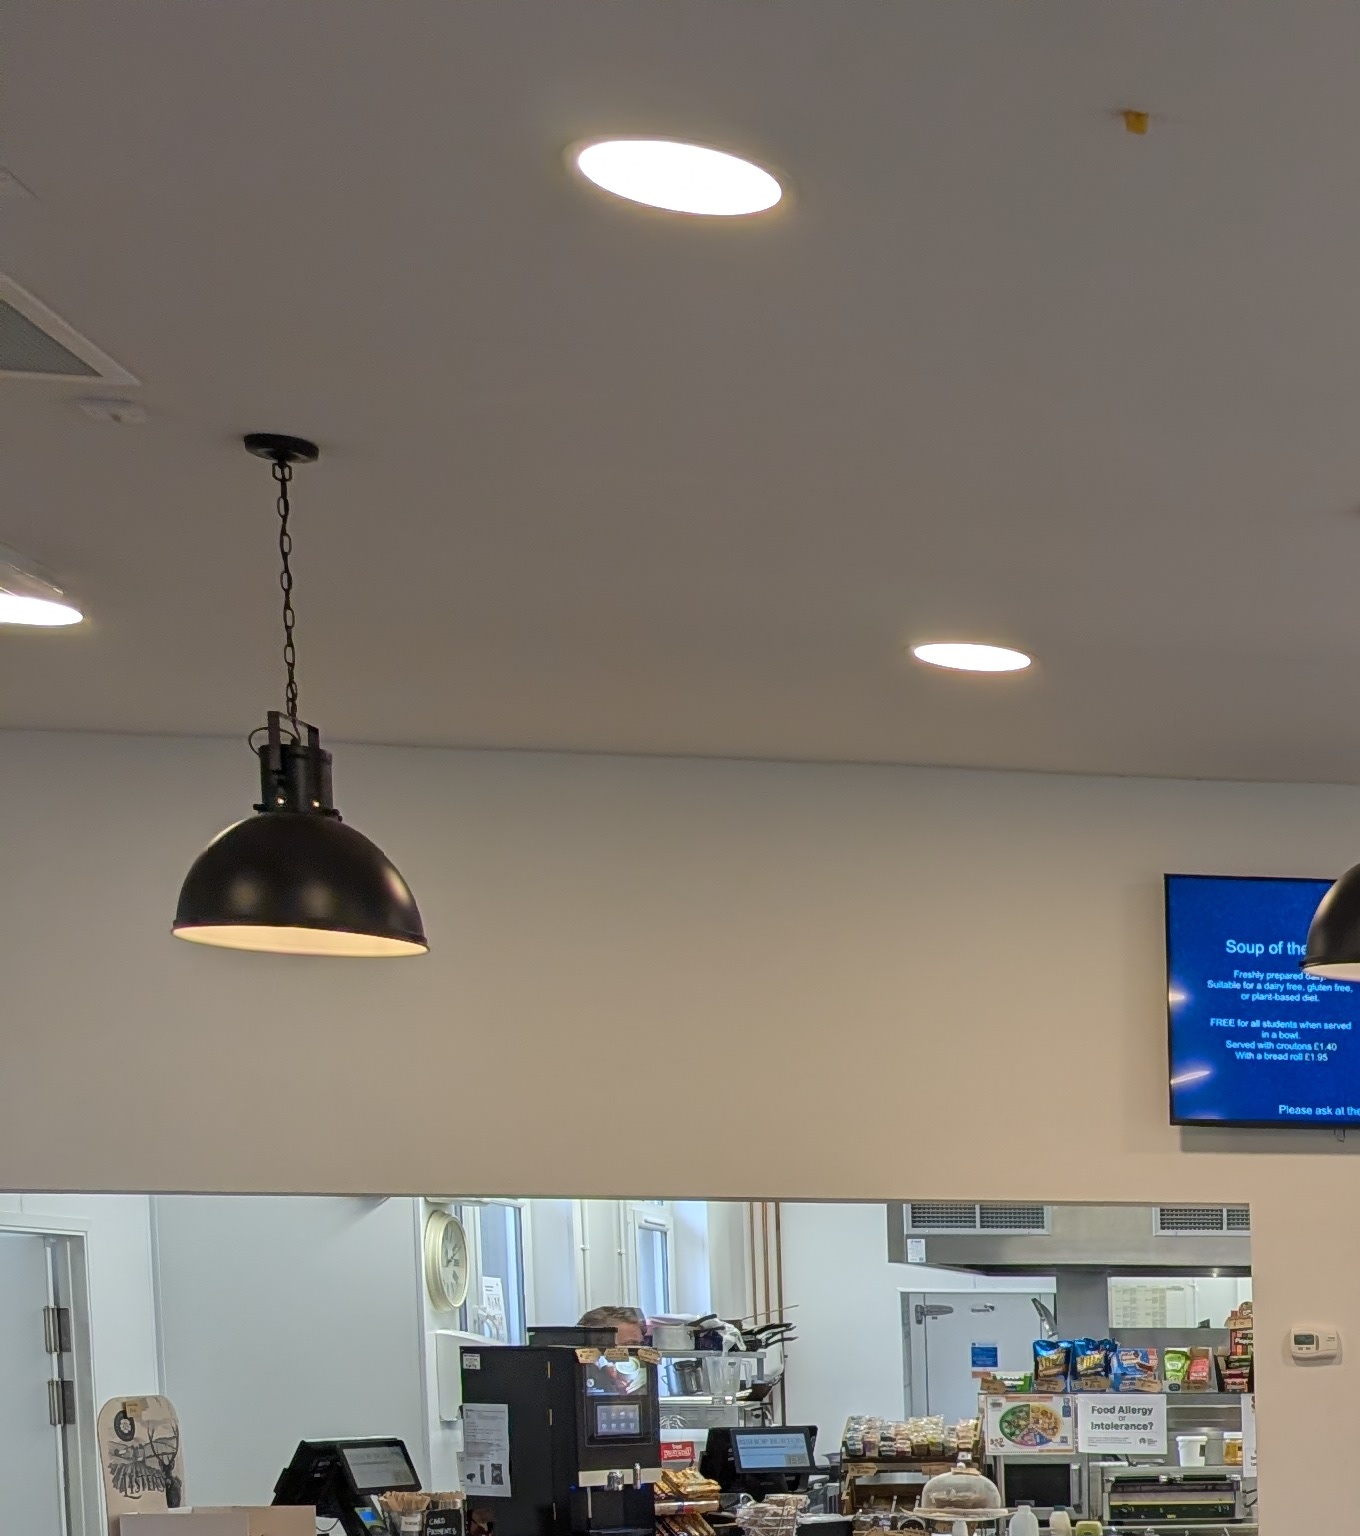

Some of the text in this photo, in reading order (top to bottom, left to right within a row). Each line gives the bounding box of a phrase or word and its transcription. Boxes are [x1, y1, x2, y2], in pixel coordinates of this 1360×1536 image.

[1225, 939, 1308, 957] Soup of the
[1233, 970, 1303, 981] Freshly prepared
[1207, 980, 1241, 989] Suitable
[1243, 980, 1254, 989] for
[1264, 981, 1284, 992] dairy
[1286, 982, 1305, 991] free,
[1307, 983, 1332, 993] gluten
[1334, 983, 1353, 993] free,
[1252, 992, 1300, 1002] plant-based
[1210, 1018, 1352, 1030] FREE for all students when served
[1279, 1031, 1301, 1039] bowl.
[1226, 1040, 1337, 1051] Served with croutons £1.40
[1235, 1051, 1254, 1060] With
[1264, 1052, 1288, 1060] bread
[1290, 1053, 1303, 1061] roll
[1304, 1053, 1328, 1061] £1.95
[1279, 1105, 1312, 1115] Please
[1315, 1105, 1332, 1115] ask
[1335, 1107, 1345, 1116] at
[1091, 1406, 1153, 1416] Food Allergy
[1090, 1422, 1154, 1430] Intolerance?
